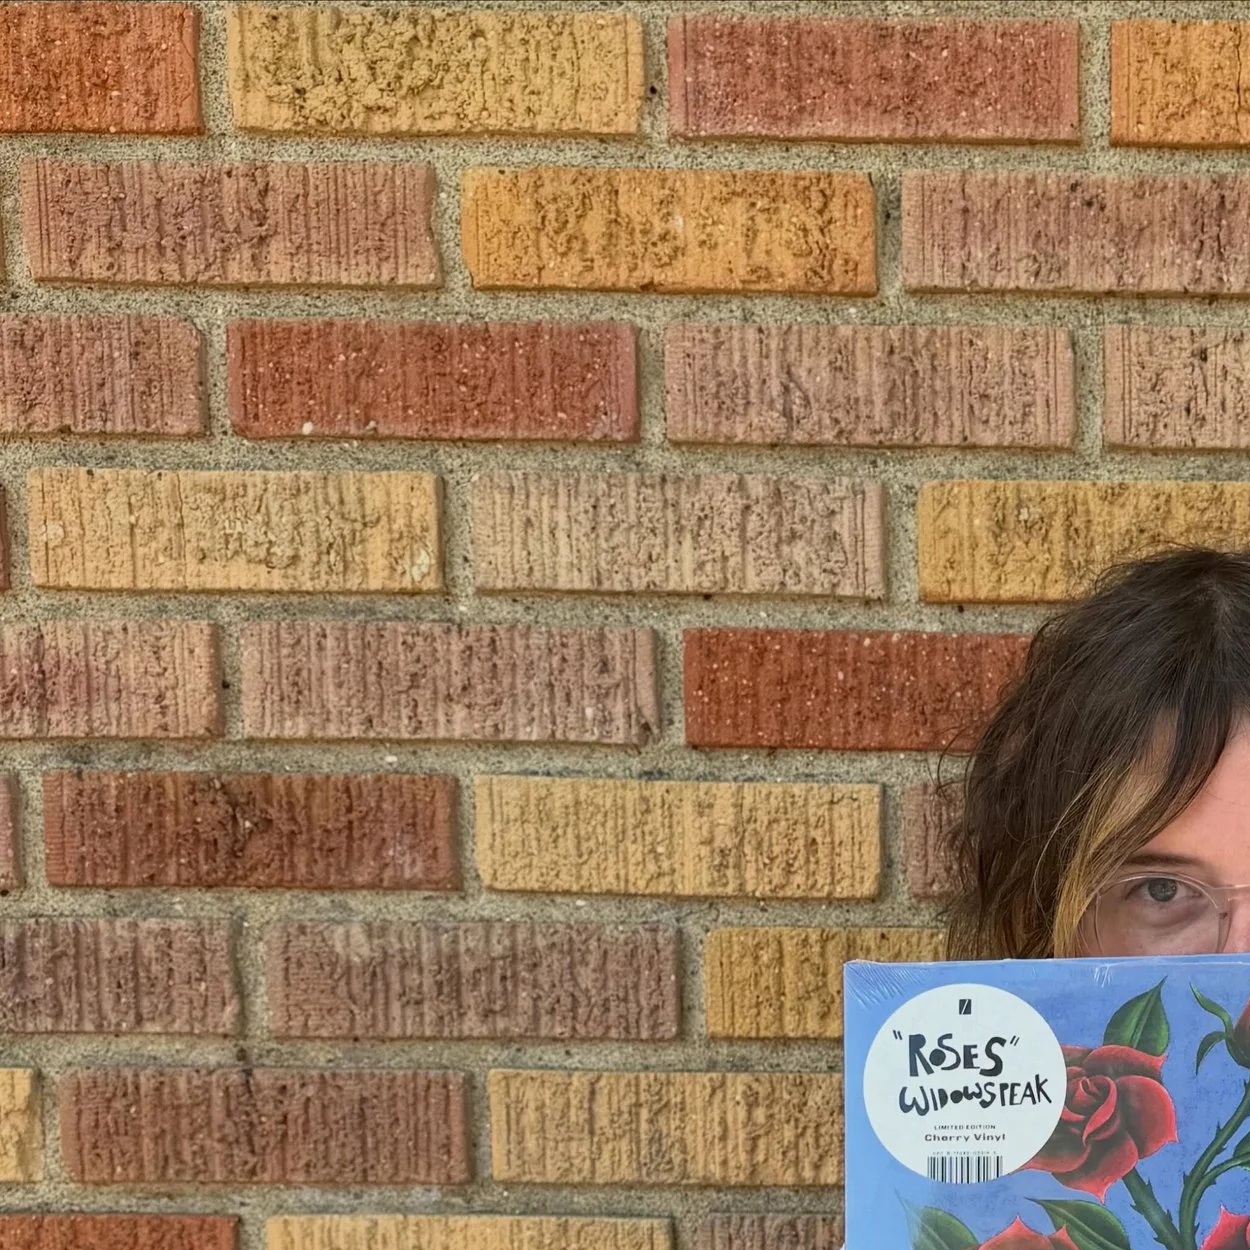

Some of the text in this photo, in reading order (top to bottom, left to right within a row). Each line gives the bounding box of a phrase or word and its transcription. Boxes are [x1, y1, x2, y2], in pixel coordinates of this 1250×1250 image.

[899, 1074, 1052, 1116] WIDOWSPEAK
[924, 1133, 1006, 1142] Cherry Vinyl
